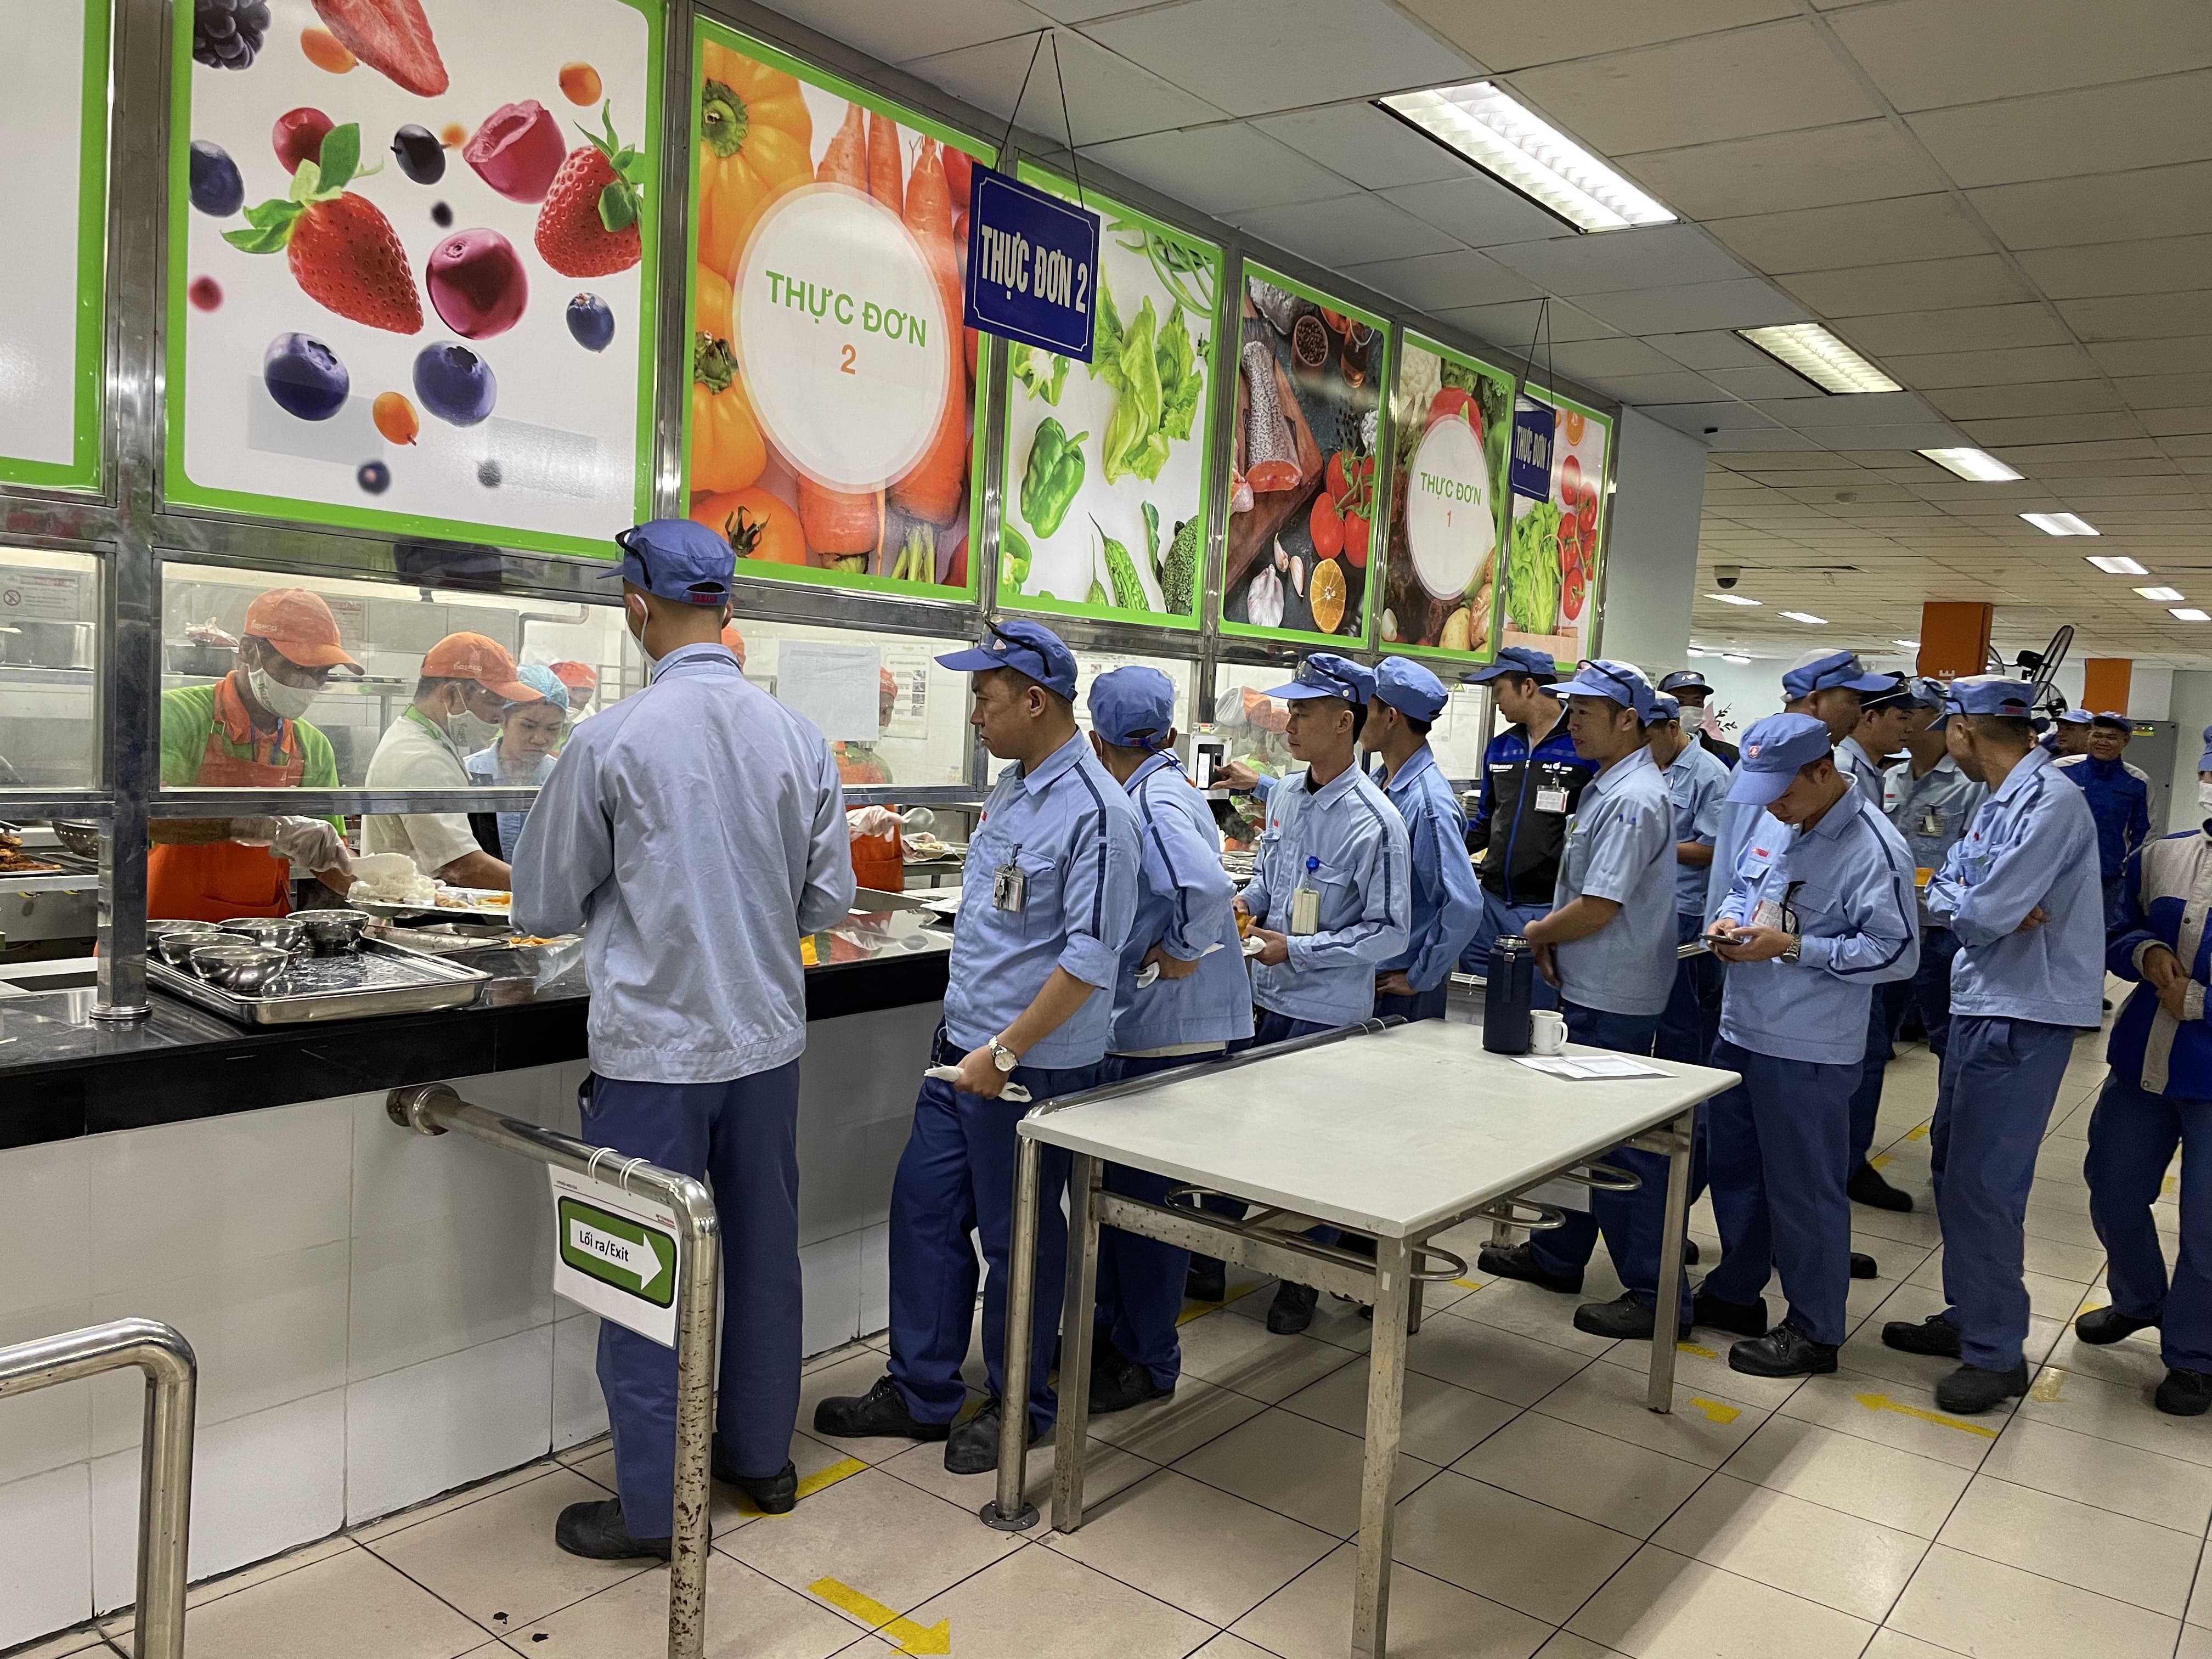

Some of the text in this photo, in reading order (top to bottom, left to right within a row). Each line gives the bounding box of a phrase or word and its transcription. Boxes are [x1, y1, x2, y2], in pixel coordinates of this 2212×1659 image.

[981, 224, 1088, 314] THỰC ĐƠN 2
[765, 269, 926, 348] THỰC ĐƠN
[840, 344, 856, 375] 2
[1515, 425, 1533, 470] THỰC
[1532, 432, 1547, 470] ĐƠN
[1420, 471, 1481, 506] THỰC ĐƠN
[1447, 510, 1452, 528] 1
[580, 1230, 629, 1262] Lối ra/Exit
